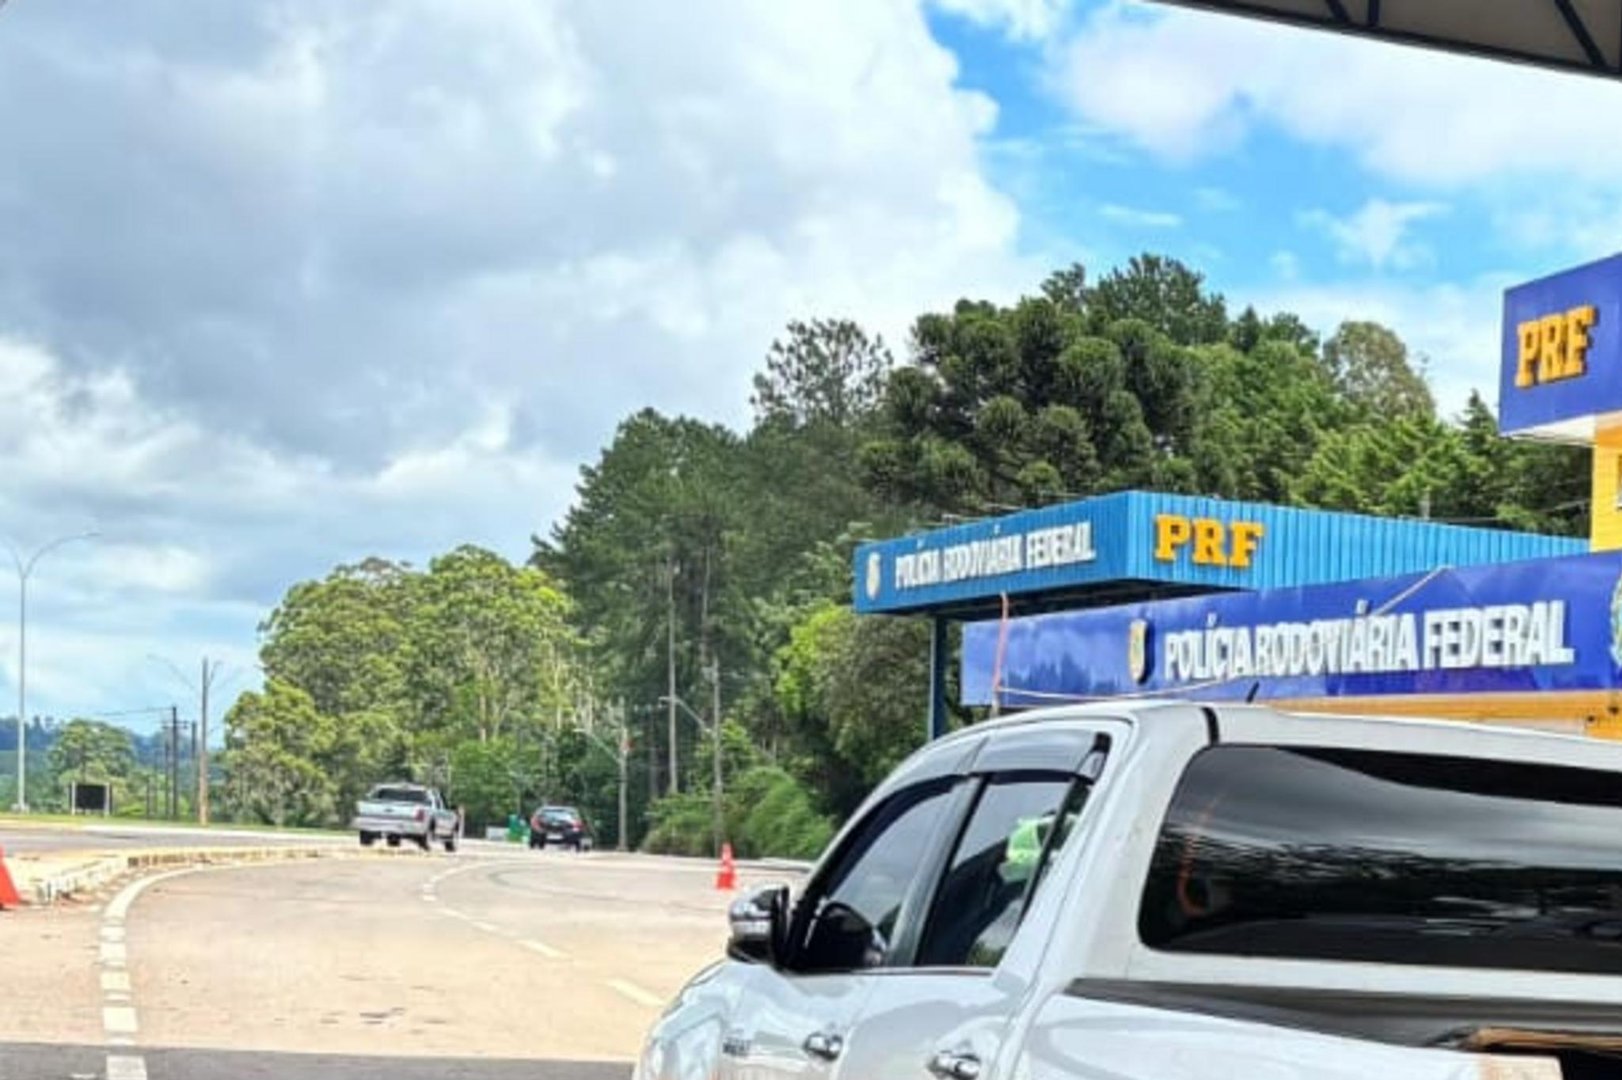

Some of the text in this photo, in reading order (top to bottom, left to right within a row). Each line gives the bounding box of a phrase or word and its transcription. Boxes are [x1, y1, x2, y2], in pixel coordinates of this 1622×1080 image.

[1514, 304, 1596, 388] PRF
[1026, 521, 1097, 570] FEDERAL
[1154, 514, 1265, 567] PRF
[1165, 599, 1575, 681] POLÍCIA RODOVIÁRIA FEDERAL
